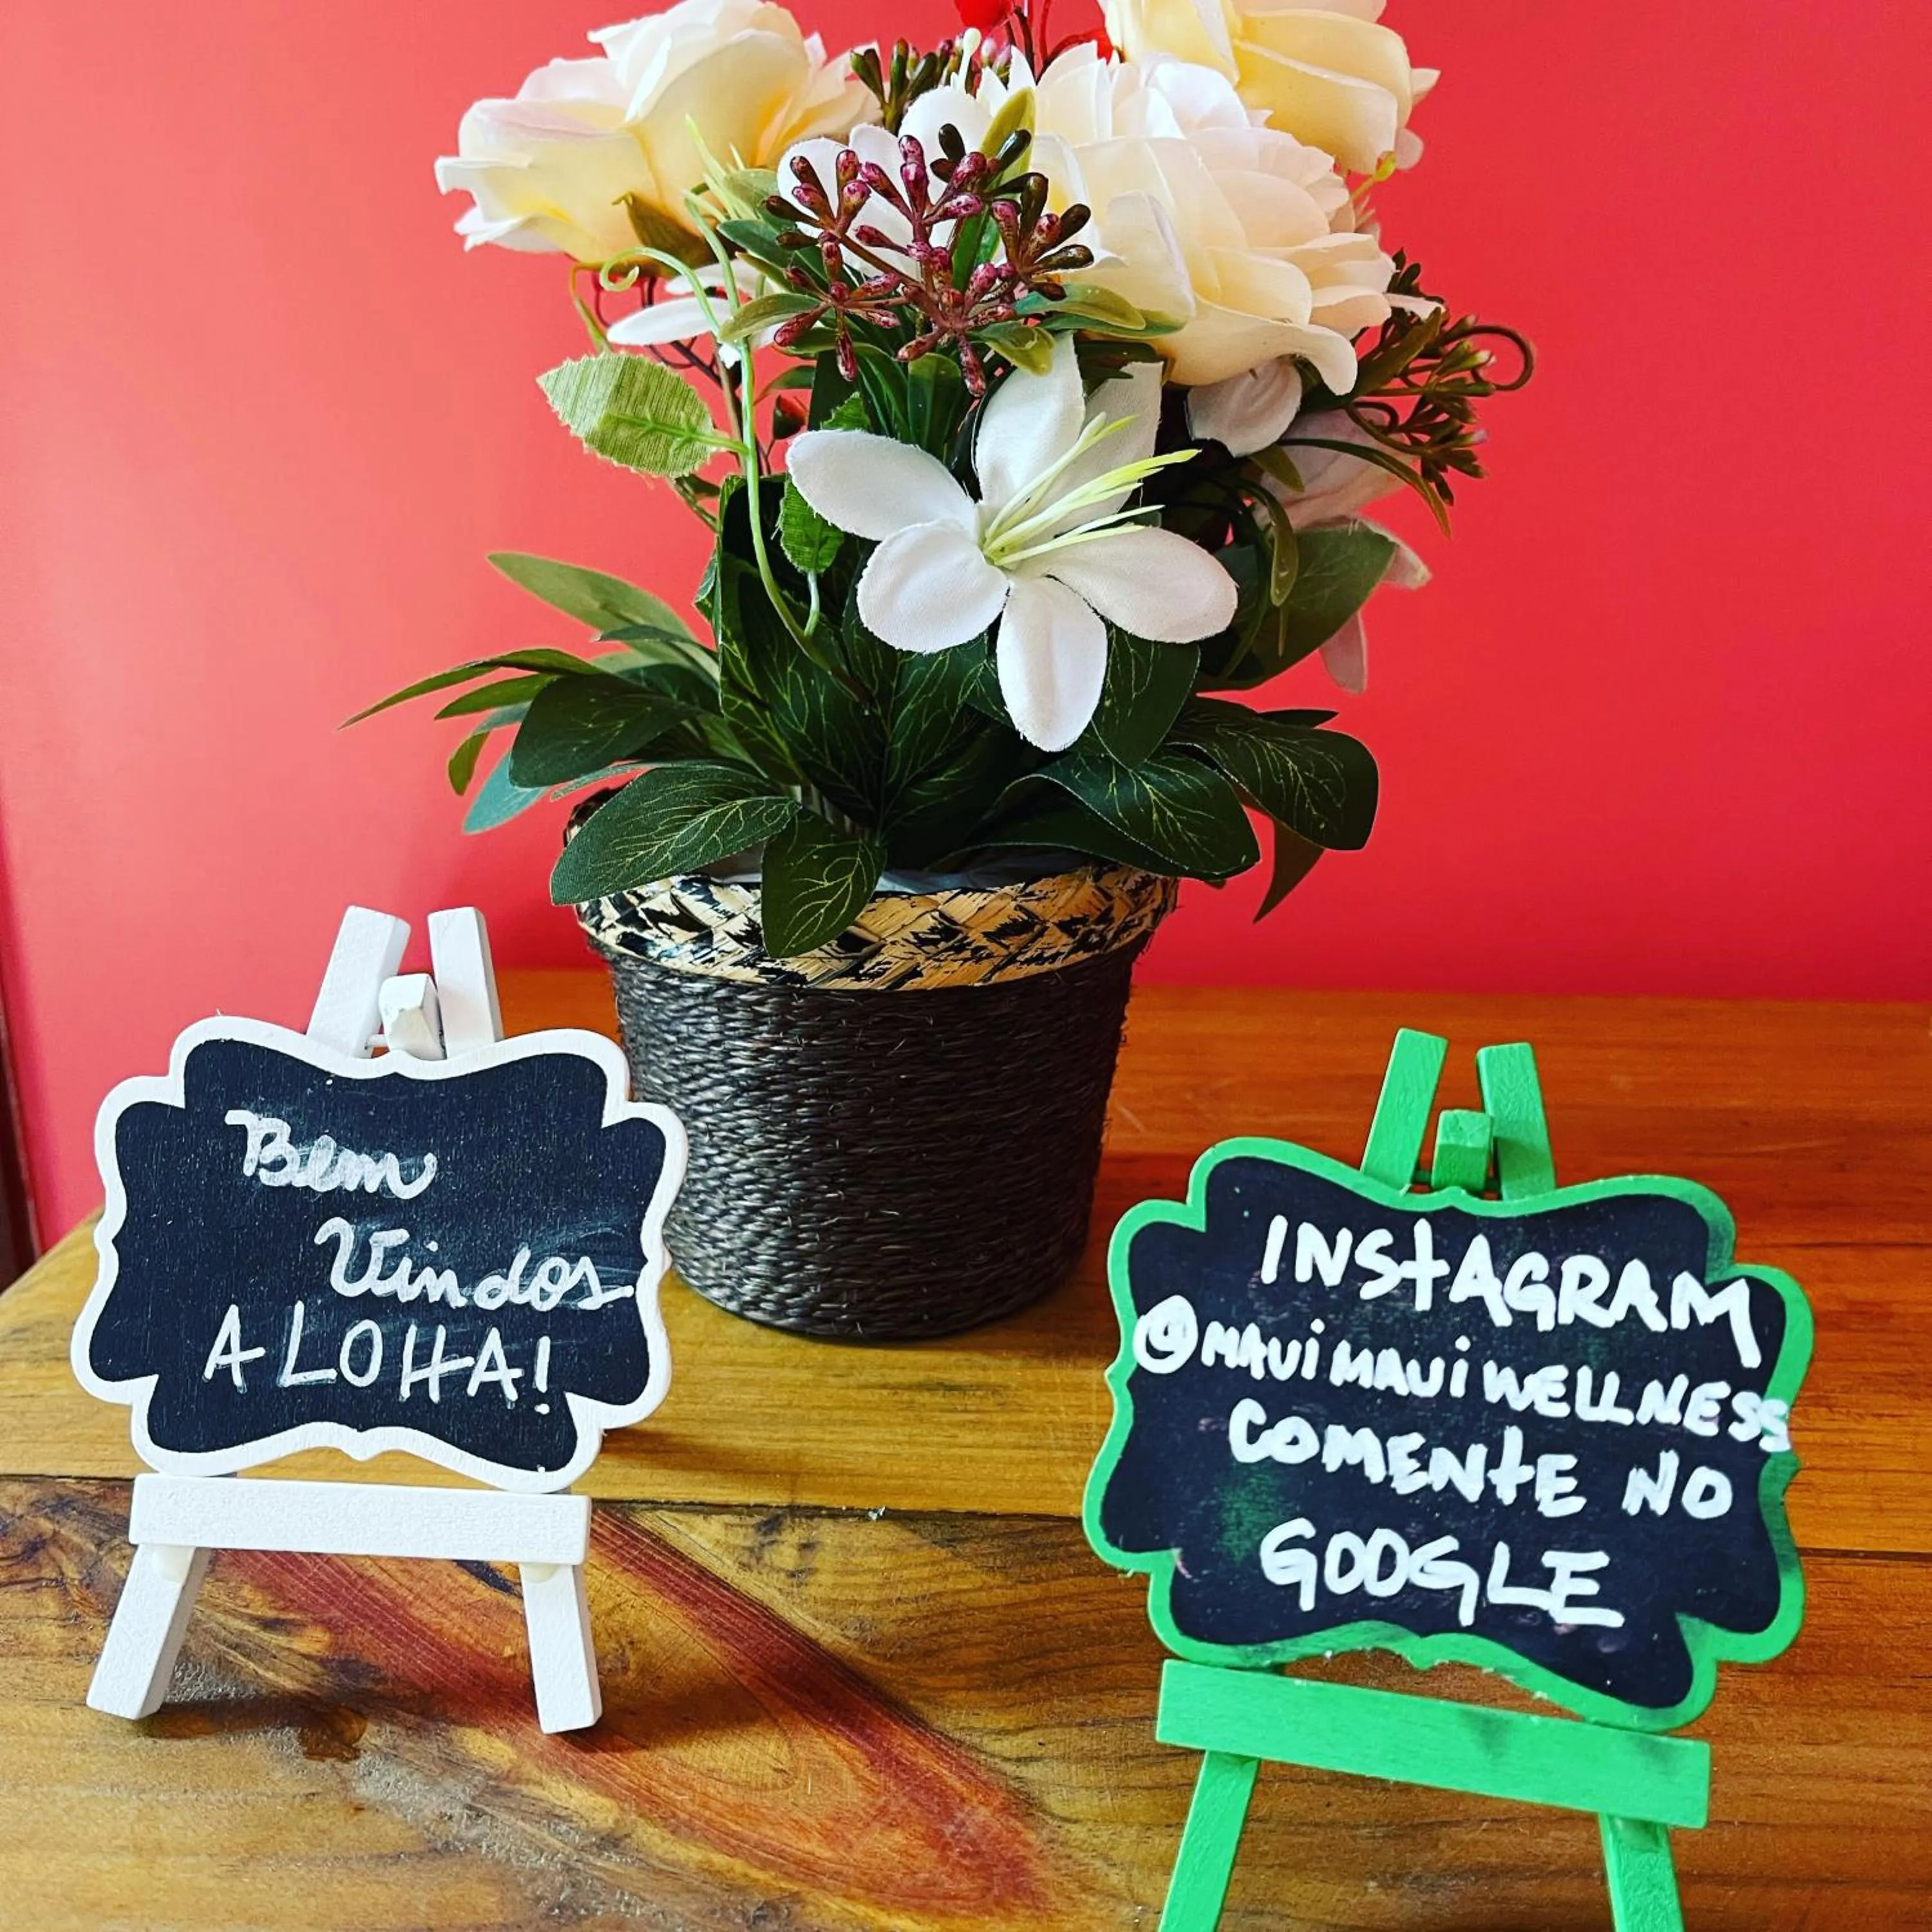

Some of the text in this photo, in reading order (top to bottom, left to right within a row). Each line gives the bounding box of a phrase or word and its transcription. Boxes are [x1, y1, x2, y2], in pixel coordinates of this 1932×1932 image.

[225, 1109, 438, 1200] Bem
[314, 1217, 634, 1310] Vindos
[203, 1300, 552, 1414] ALOHA!
[1622, 1450, 1733, 1519] NO
[1260, 1518, 1625, 1627] GOOGLE
